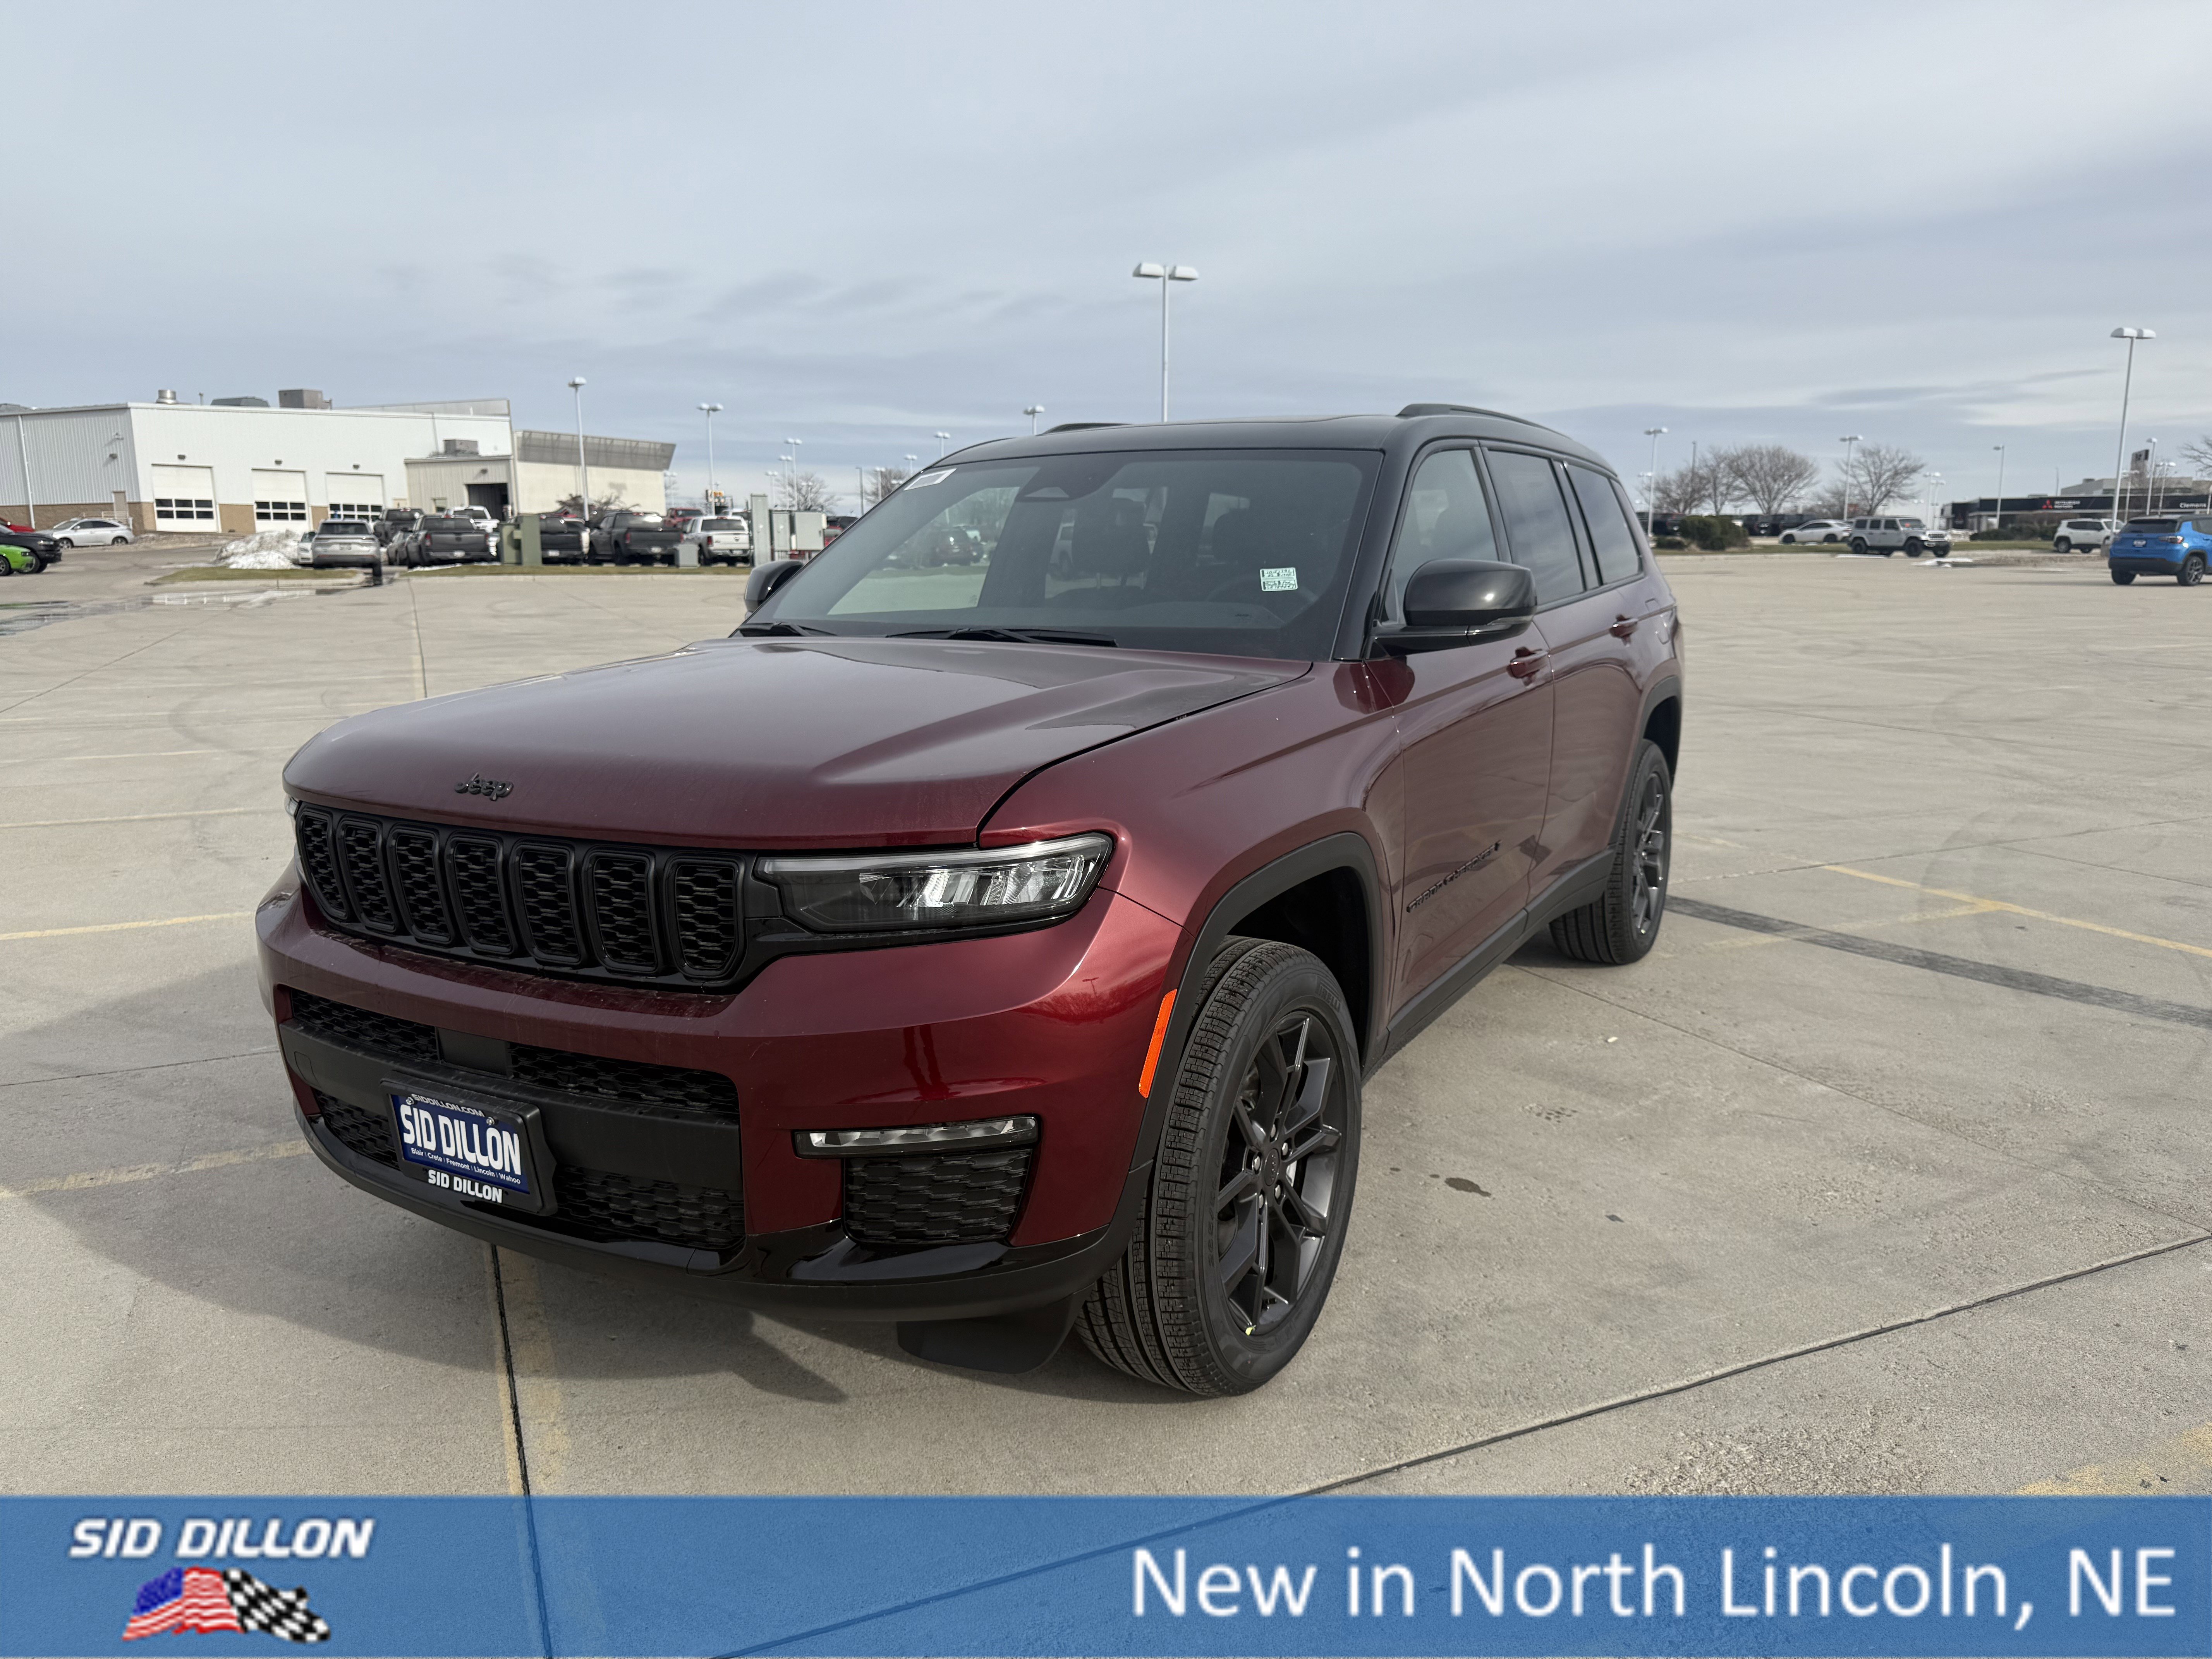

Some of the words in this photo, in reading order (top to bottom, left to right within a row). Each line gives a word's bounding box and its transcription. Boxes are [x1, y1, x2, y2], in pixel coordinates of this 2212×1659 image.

[454, 772, 514, 802] Jeep
[411, 1094, 485, 1117] SIDDILLON.COM
[400, 1104, 436, 1151] SID
[438, 1115, 521, 1175] DILLON
[411, 1147, 424, 1156] Blair
[427, 1152, 443, 1162] Crete
[446, 1158, 470, 1170] Fremont
[474, 1166, 495, 1177] Lincoln
[498, 1173, 521, 1184] Wahoo
[428, 1169, 450, 1188] SID
[453, 1176, 502, 1203] DILLON
